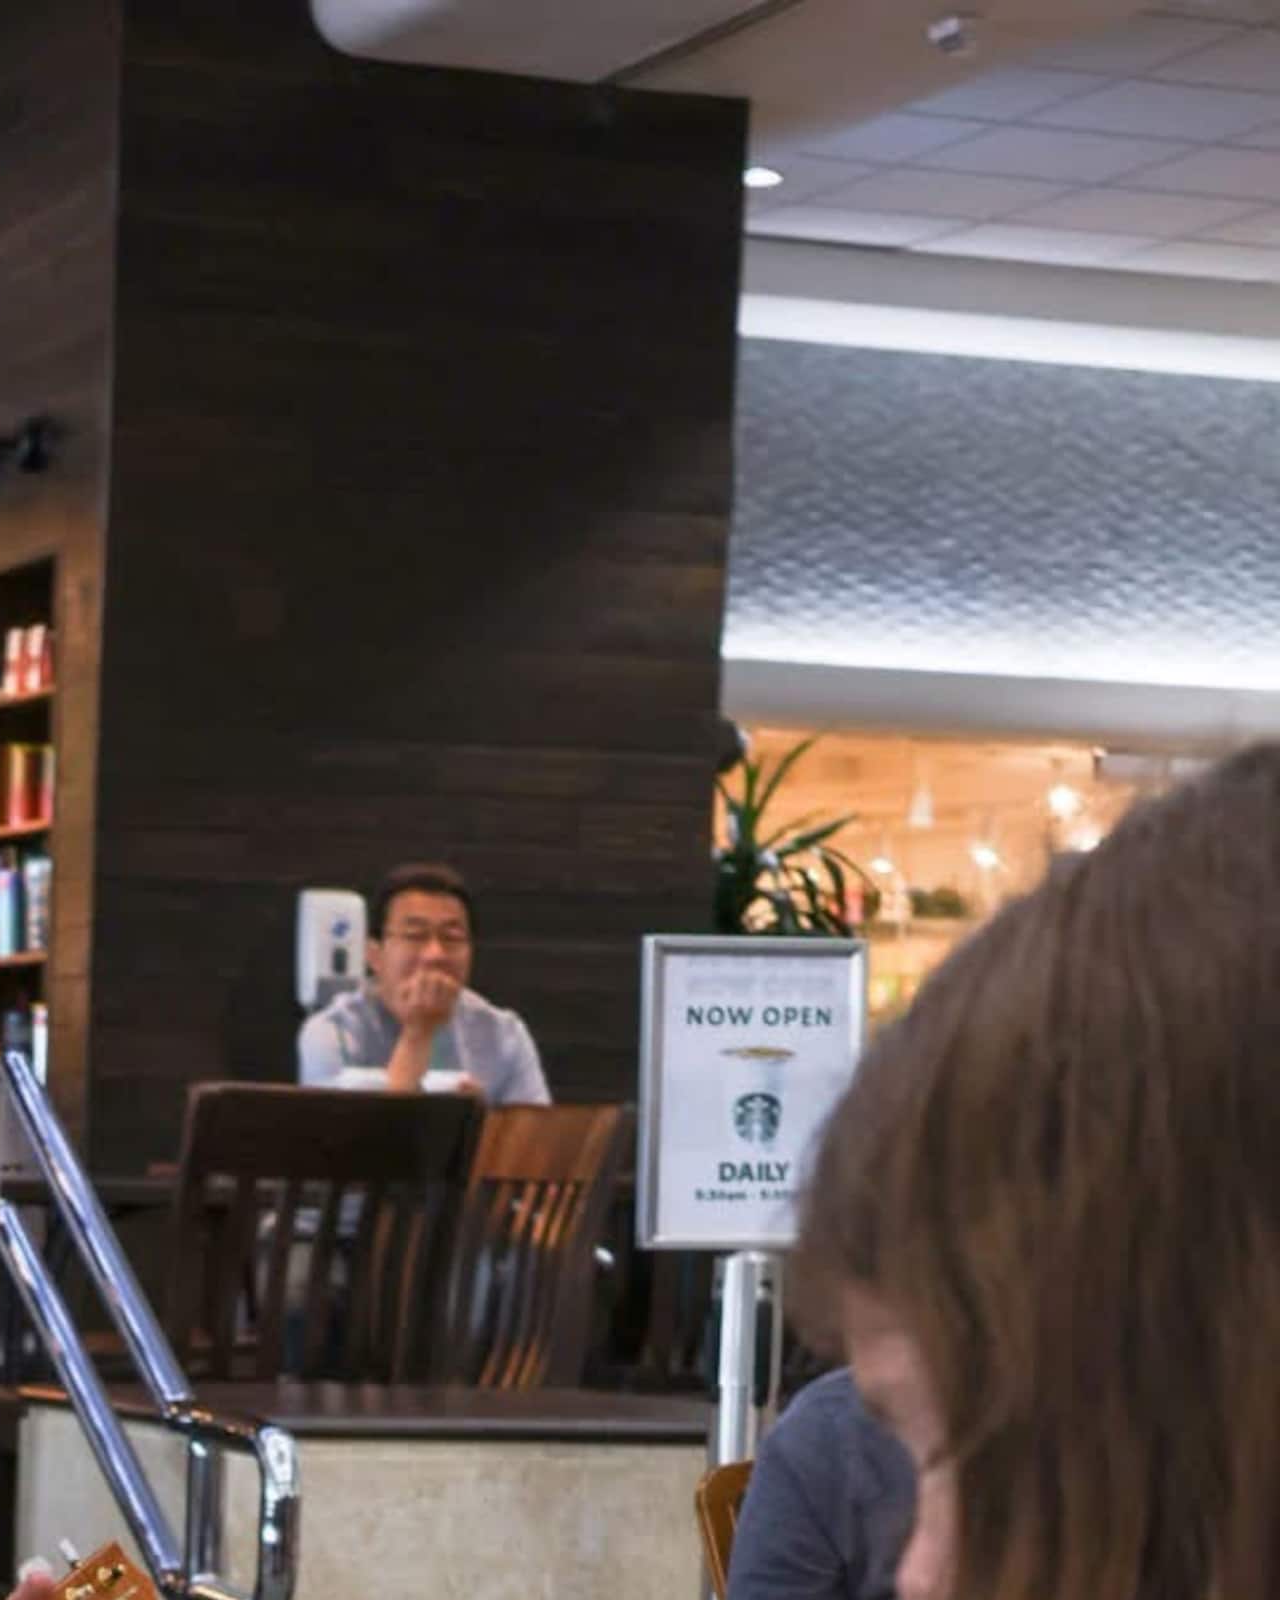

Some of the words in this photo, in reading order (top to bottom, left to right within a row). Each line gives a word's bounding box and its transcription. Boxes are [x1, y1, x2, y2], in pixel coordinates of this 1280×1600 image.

[686, 1006, 753, 1027] NOW
[762, 1006, 833, 1027] OPEN
[718, 1161, 790, 1182] DAILY
